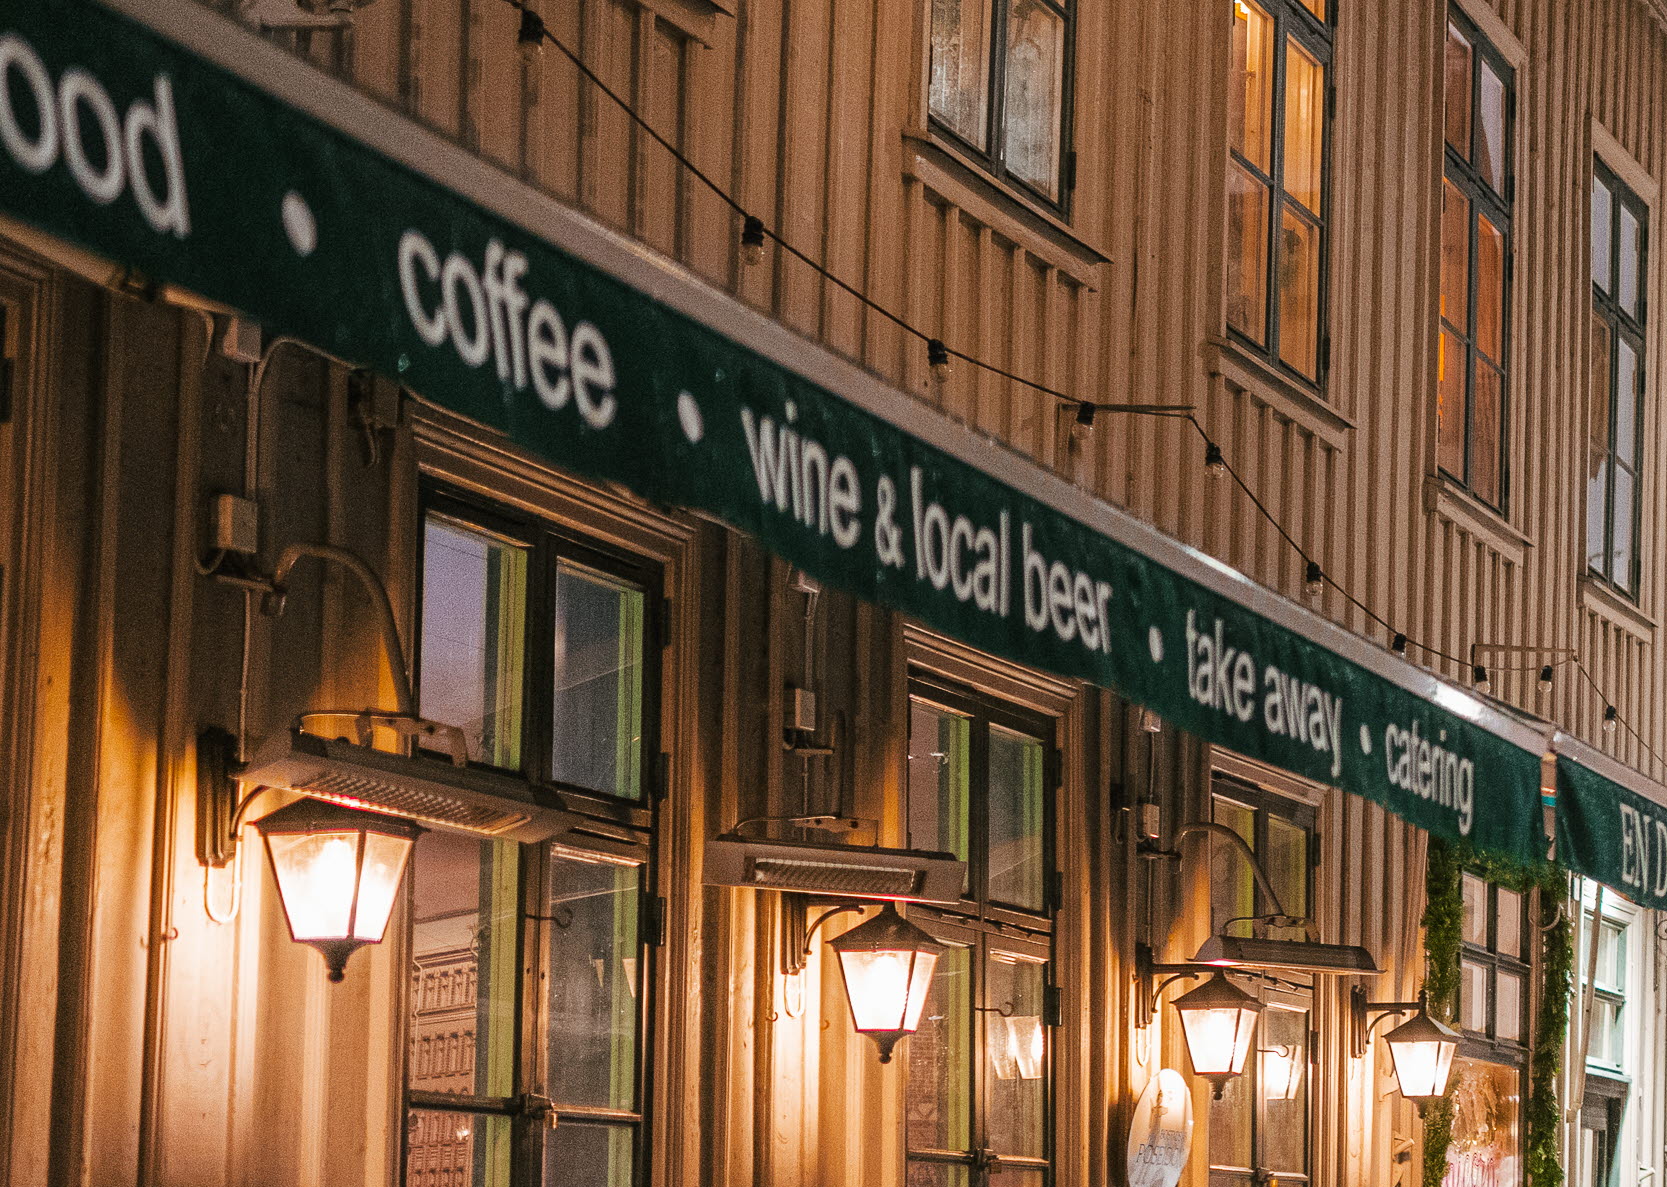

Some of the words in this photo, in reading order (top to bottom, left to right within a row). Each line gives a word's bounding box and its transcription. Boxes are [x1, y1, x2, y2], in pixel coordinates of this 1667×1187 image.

[398, 230, 617, 430] coffee
[741, 400, 861, 549] wine
[874, 475, 904, 570] &
[910, 466, 1010, 616] local
[1022, 522, 1113, 654] beer
[1185, 607, 1257, 723] take
[1264, 664, 1343, 779] away
[1384, 717, 1475, 837] catering
[1619, 802, 1652, 895] EN
